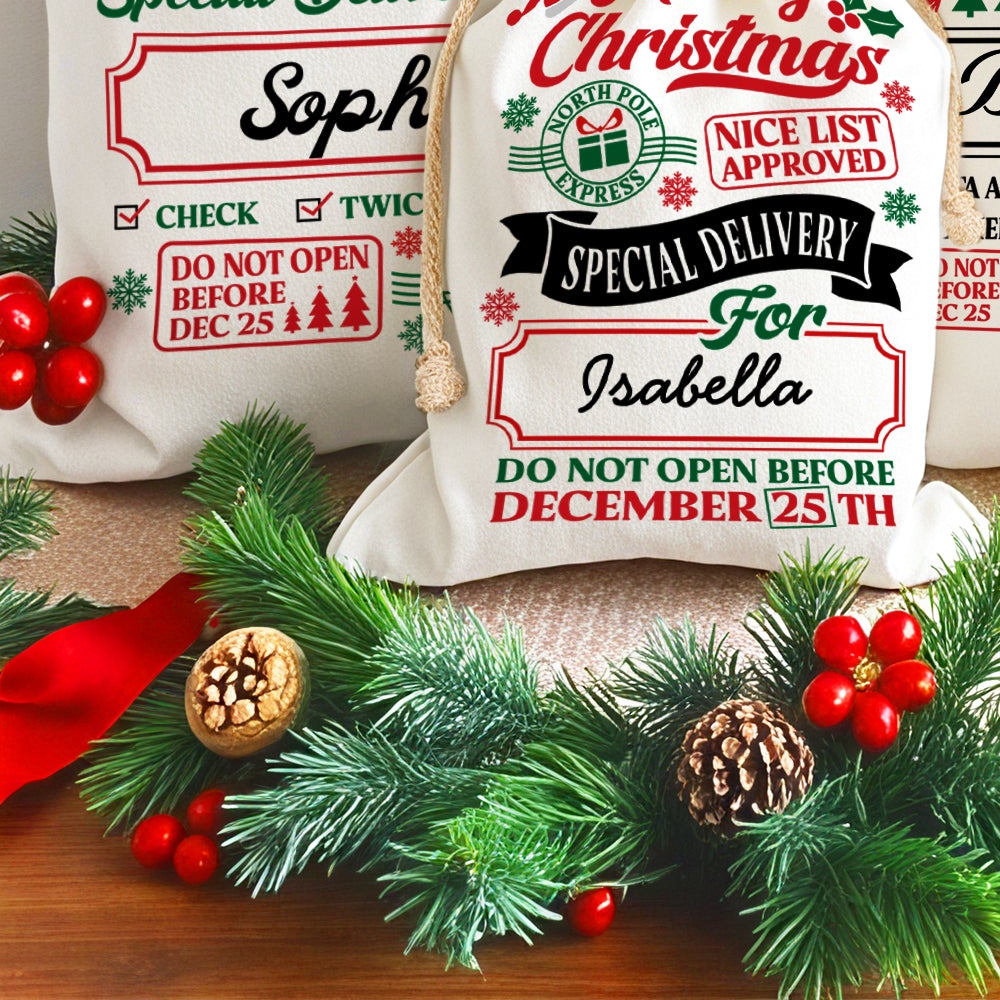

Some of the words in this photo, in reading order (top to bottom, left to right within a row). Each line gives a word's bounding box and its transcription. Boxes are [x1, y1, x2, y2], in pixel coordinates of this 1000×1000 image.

[529, 12, 889, 99] Christmas
[240, 54, 431, 158] Soph
[548, 84, 612, 136] NORTH
[618, 86, 659, 131] POLE
[714, 117, 800, 150] NICE
[808, 115, 880, 144] LIST
[722, 148, 886, 182] APPROVED
[555, 169, 646, 204] EXPRESS
[156, 202, 258, 228] CHECK
[340, 193, 422, 219] TWIC
[172, 254, 215, 281] DO
[224, 250, 284, 278] NOT
[290, 244, 368, 273] OPEN
[562, 238, 698, 292] SPECIAL
[698, 212, 858, 272] DELIVERY
[955, 258, 999, 278] NOT
[173, 281, 286, 310] BEFORE
[938, 282, 1000, 300] FORE
[170, 314, 229, 340] DEC
[238, 311, 273, 335] 25
[700, 285, 827, 350] For
[964, 304, 990, 322] 25
[578, 353, 812, 413] Isabella
[497, 458, 556, 482] DO
[568, 458, 649, 482] NOT
[657, 458, 756, 483] OPEN
[768, 459, 895, 485] BEFORE
[490, 490, 761, 522] DECEMBER
[772, 492, 826, 524] 25
[838, 494, 896, 526] TH
